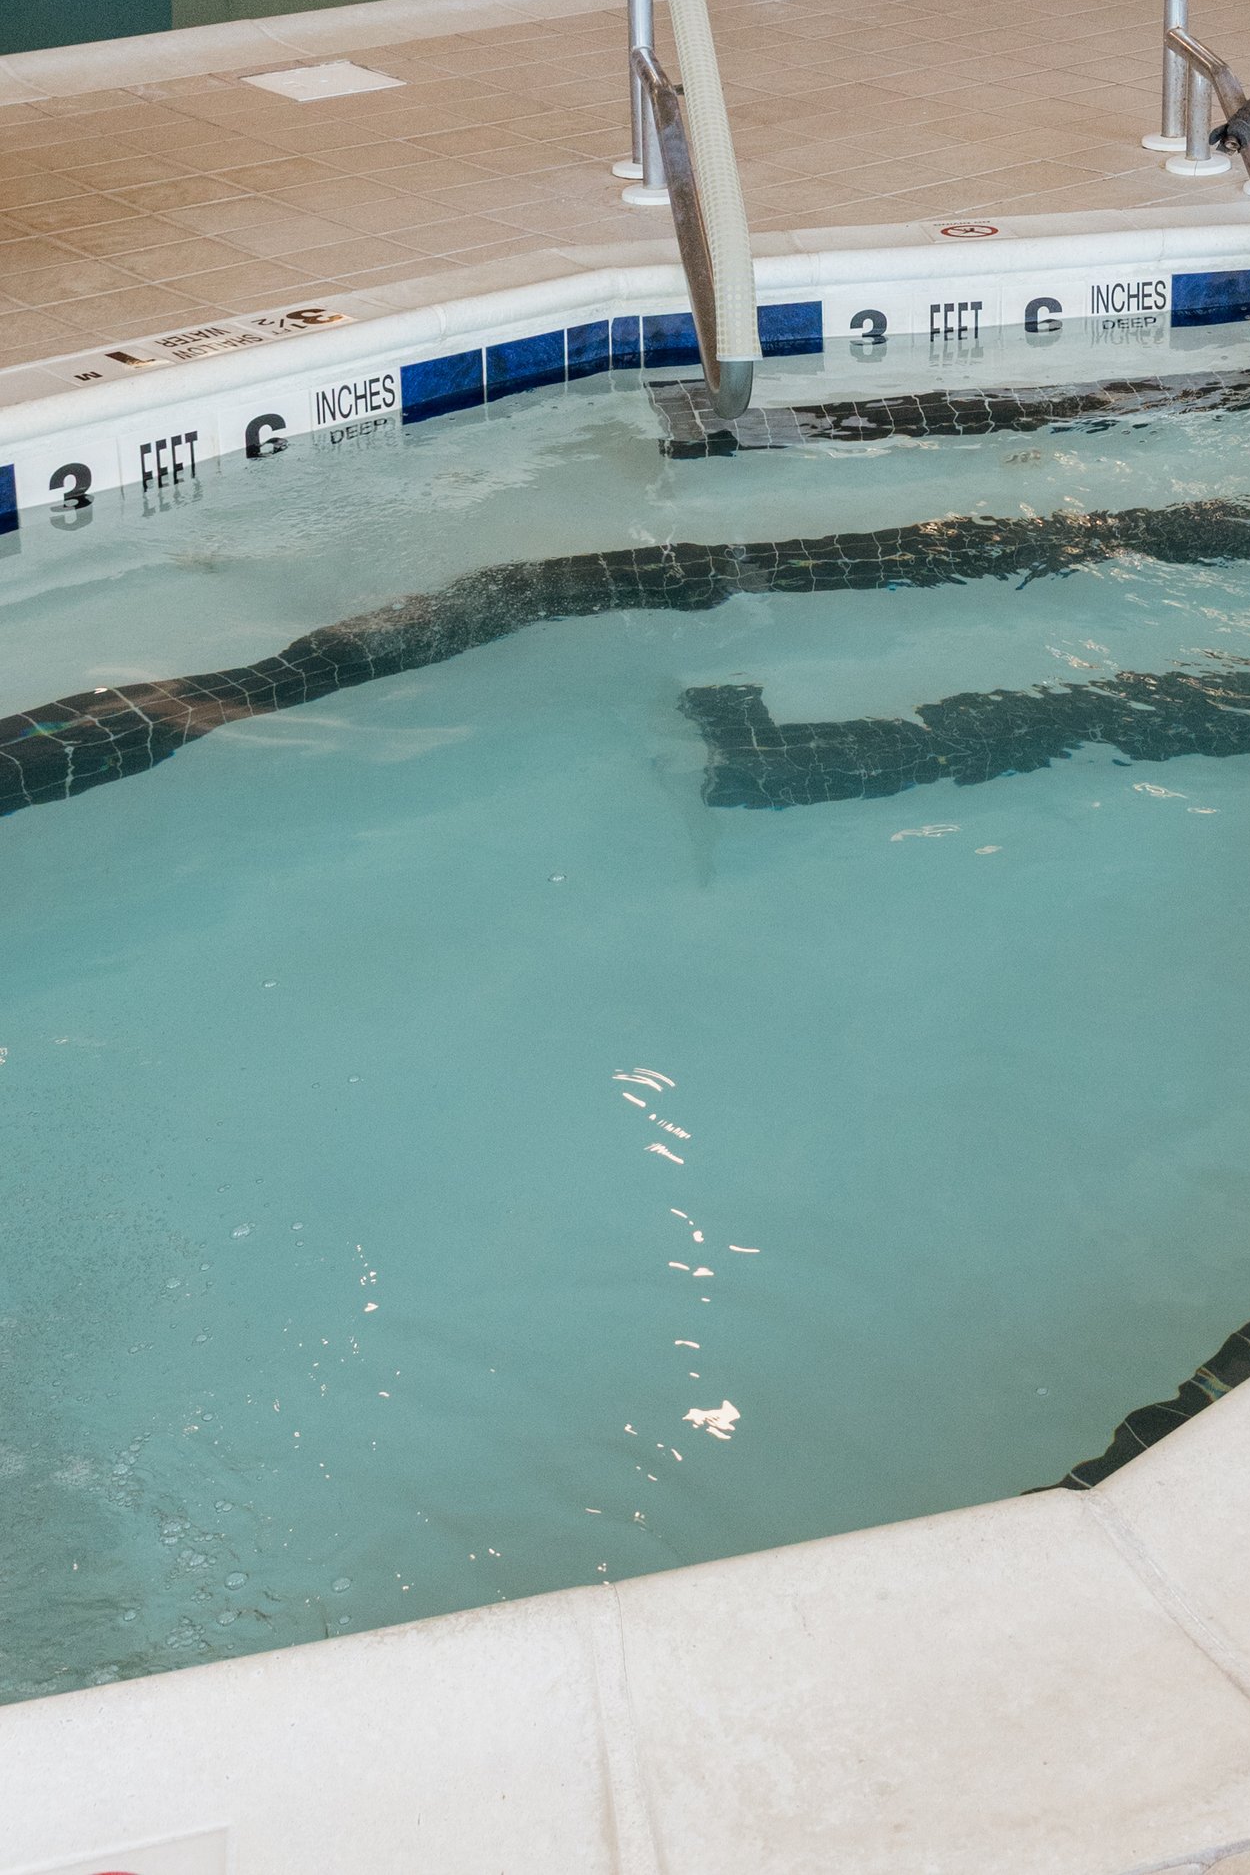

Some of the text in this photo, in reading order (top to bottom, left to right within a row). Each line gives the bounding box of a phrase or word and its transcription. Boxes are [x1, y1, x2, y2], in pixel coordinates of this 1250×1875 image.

[850, 309, 889, 346] 3
[930, 301, 983, 343] FEET
[1091, 280, 1167, 315] INCHES
[156, 327, 230, 347] WATER
[172, 333, 263, 360] SHALLOW
[49, 463, 94, 509] 3
[140, 431, 199, 492] FEET
[315, 374, 396, 425] INCHES
